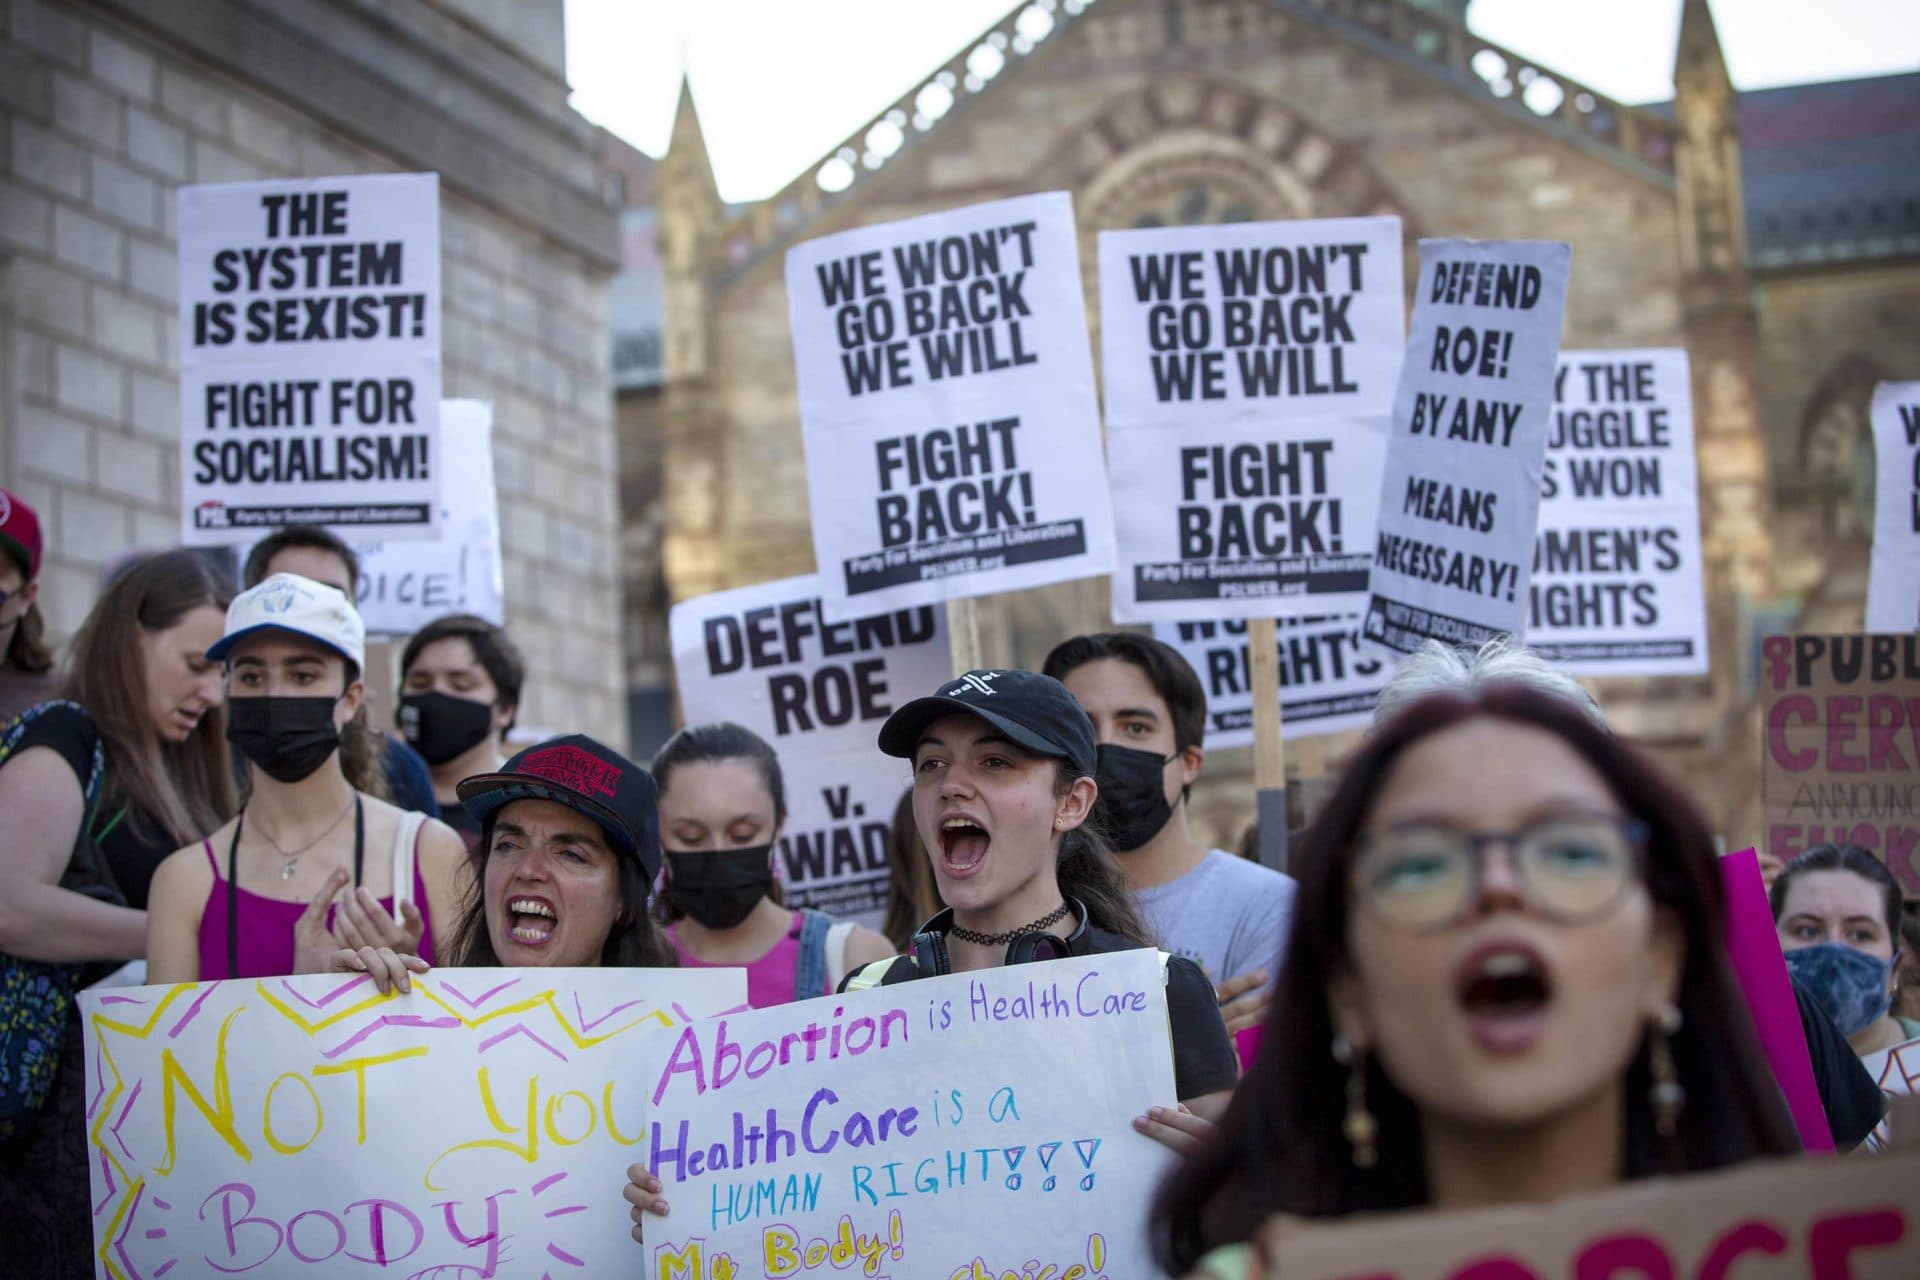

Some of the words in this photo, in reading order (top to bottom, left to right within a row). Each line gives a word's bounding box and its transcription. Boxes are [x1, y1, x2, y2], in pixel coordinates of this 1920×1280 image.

[261, 191, 349, 238] THE
[212, 242, 402, 293] SYSTEM
[816, 251, 886, 307] WE
[894, 221, 1038, 290] WON'T
[1129, 251, 1205, 302] WE
[1214, 244, 1369, 298] WON'T
[1431, 261, 1542, 310] DEFEND
[194, 303, 235, 346] IS
[246, 295, 426, 343] SEXIST!
[836, 298, 895, 350] GO
[904, 271, 1031, 337] BACK
[1148, 302, 1212, 352] GO
[1222, 295, 1356, 348] BACK
[841, 341, 913, 397] WE
[921, 321, 1038, 381] WILL
[1150, 351, 1227, 403] WE
[1237, 347, 1358, 398] WILL
[1431, 325, 1513, 379] ROE!
[206, 381, 320, 429] FIGHT
[330, 379, 415, 425] FOR
[1580, 364, 1655, 403] THE
[1410, 392, 1447, 436] BY
[1447, 397, 1523, 447] ANY
[194, 435, 429, 485] SOCIALISM!
[875, 416, 1020, 491] FIGHT
[1180, 440, 1333, 501] FIGHT
[1568, 457, 1661, 498] WON
[284, 508, 336, 523] Socialism
[338, 507, 358, 522] and
[360, 506, 422, 521] Liberation
[876, 472, 1037, 548] BACK!
[1178, 499, 1343, 560] BACK!
[1403, 475, 1496, 534] MEANS
[910, 538, 975, 561] Socialism
[976, 534, 1001, 550] and
[1004, 523, 1078, 546] Liberation
[1208, 561, 1278, 578] Socialism
[1279, 558, 1307, 575] and
[1376, 531, 1518, 602] NECESSARY!
[1532, 528, 1681, 574] MEN'S
[1530, 582, 1659, 628] IGHTS
[1794, 634, 1920, 687] PUBL
[767, 658, 891, 737] ROE
[651, 1005, 909, 1107] Abortion
[927, 998, 953, 1032] is
[152, 1004, 430, 1176] NOT
[932, 1087, 962, 1127] is
[987, 1085, 1021, 1124] a
[710, 1172, 823, 1232] HUMAN
[198, 1182, 518, 1279] BODY
[762, 1208, 905, 1280] Body!
